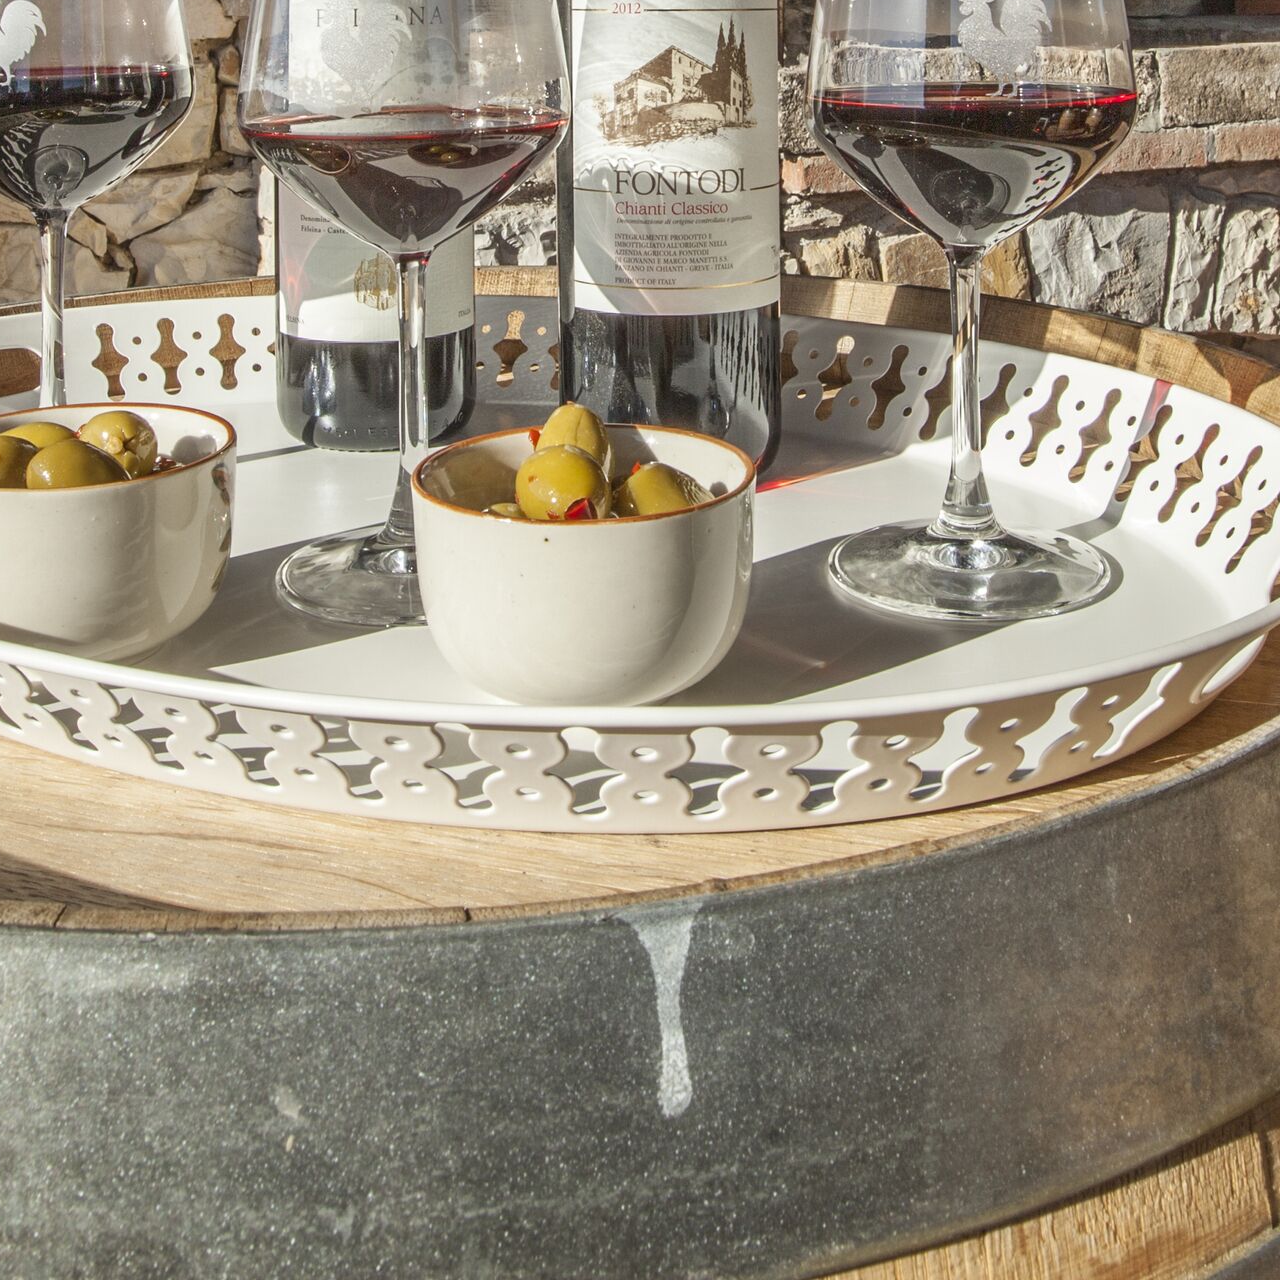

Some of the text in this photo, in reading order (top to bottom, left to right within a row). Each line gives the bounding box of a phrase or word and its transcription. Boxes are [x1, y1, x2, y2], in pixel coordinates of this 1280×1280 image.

[611, 2, 641, 14] 2012
[615, 167, 747, 196] FONTODI
[615, 200, 729, 216] Chianti Classico
[672, 218, 695, 227] origine
[614, 233, 668, 241] INTEGRALMENTE
[670, 233, 707, 241] PRODOTTO
[614, 241, 666, 249] IMBOTTIGLIATO
[708, 240, 728, 248] NELLA
[678, 249, 709, 257] FONTODI
[689, 256, 718, 264] MANETTI
[689, 264, 710, 272] GREVE
[714, 263, 734, 271] ITALIA
